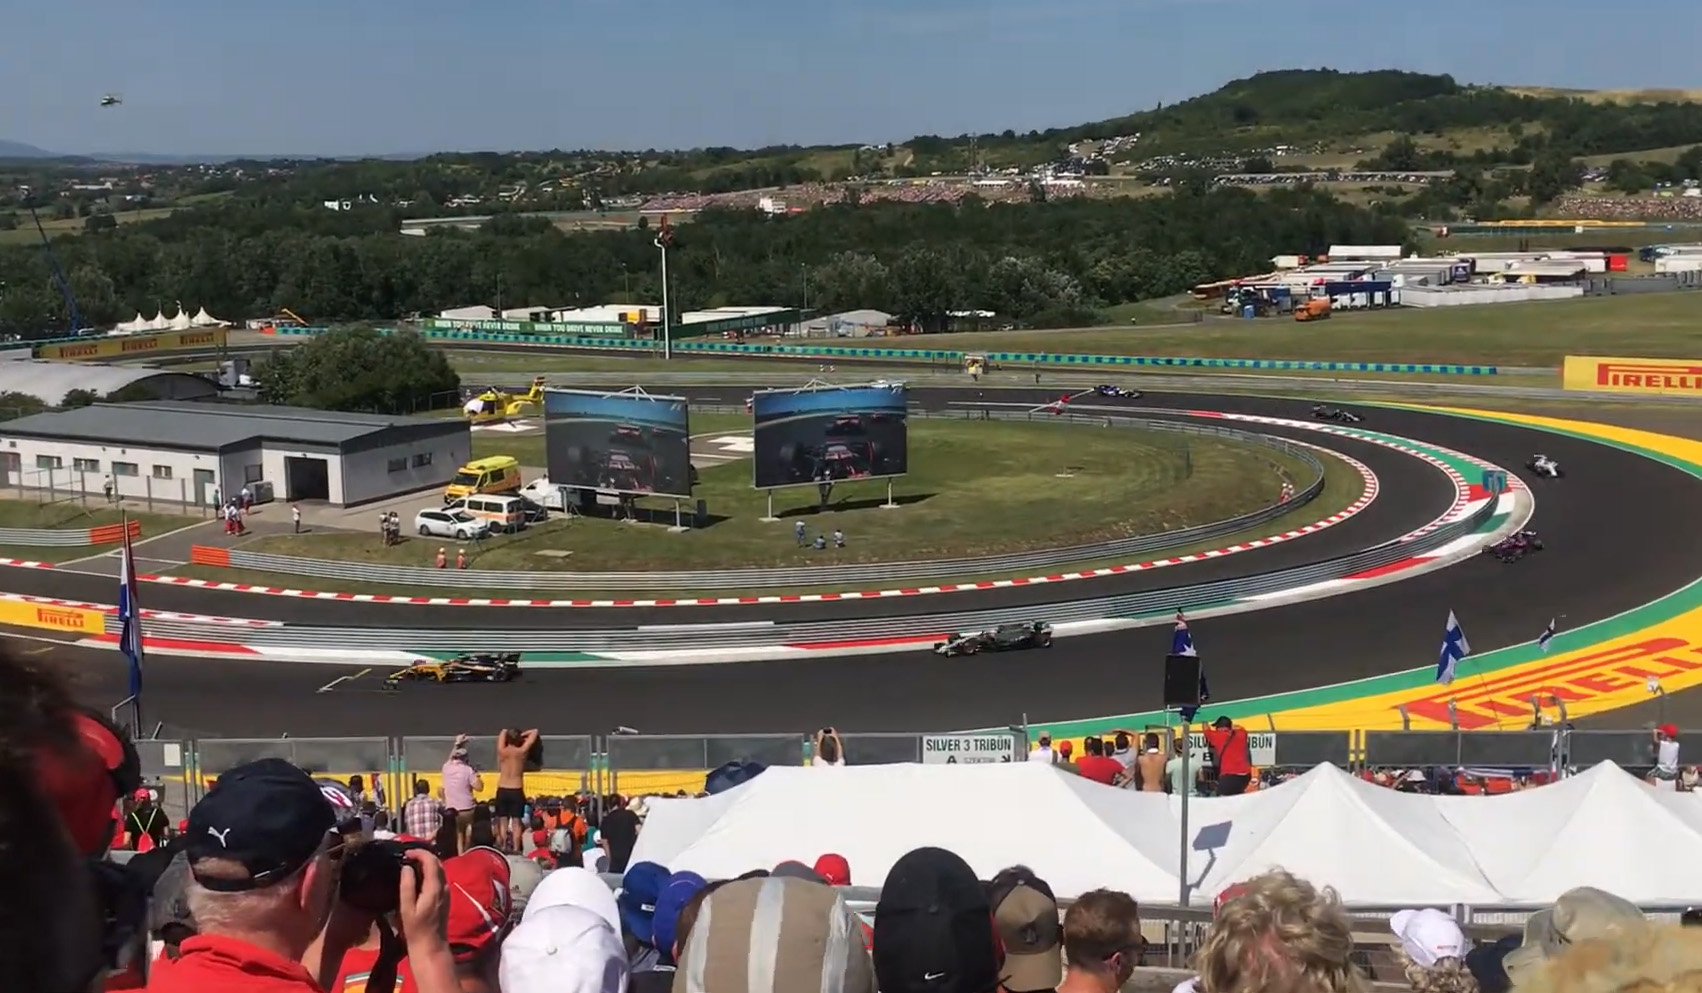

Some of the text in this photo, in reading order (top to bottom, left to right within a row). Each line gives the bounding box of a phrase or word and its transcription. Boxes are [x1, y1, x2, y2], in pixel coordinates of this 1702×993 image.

[37, 608, 84, 627] PIRELLI
[1391, 637, 1702, 730] PIRELL
[926, 738, 960, 751] SILVER
[963, 738, 970, 751] 3
[947, 755, 957, 764] A
